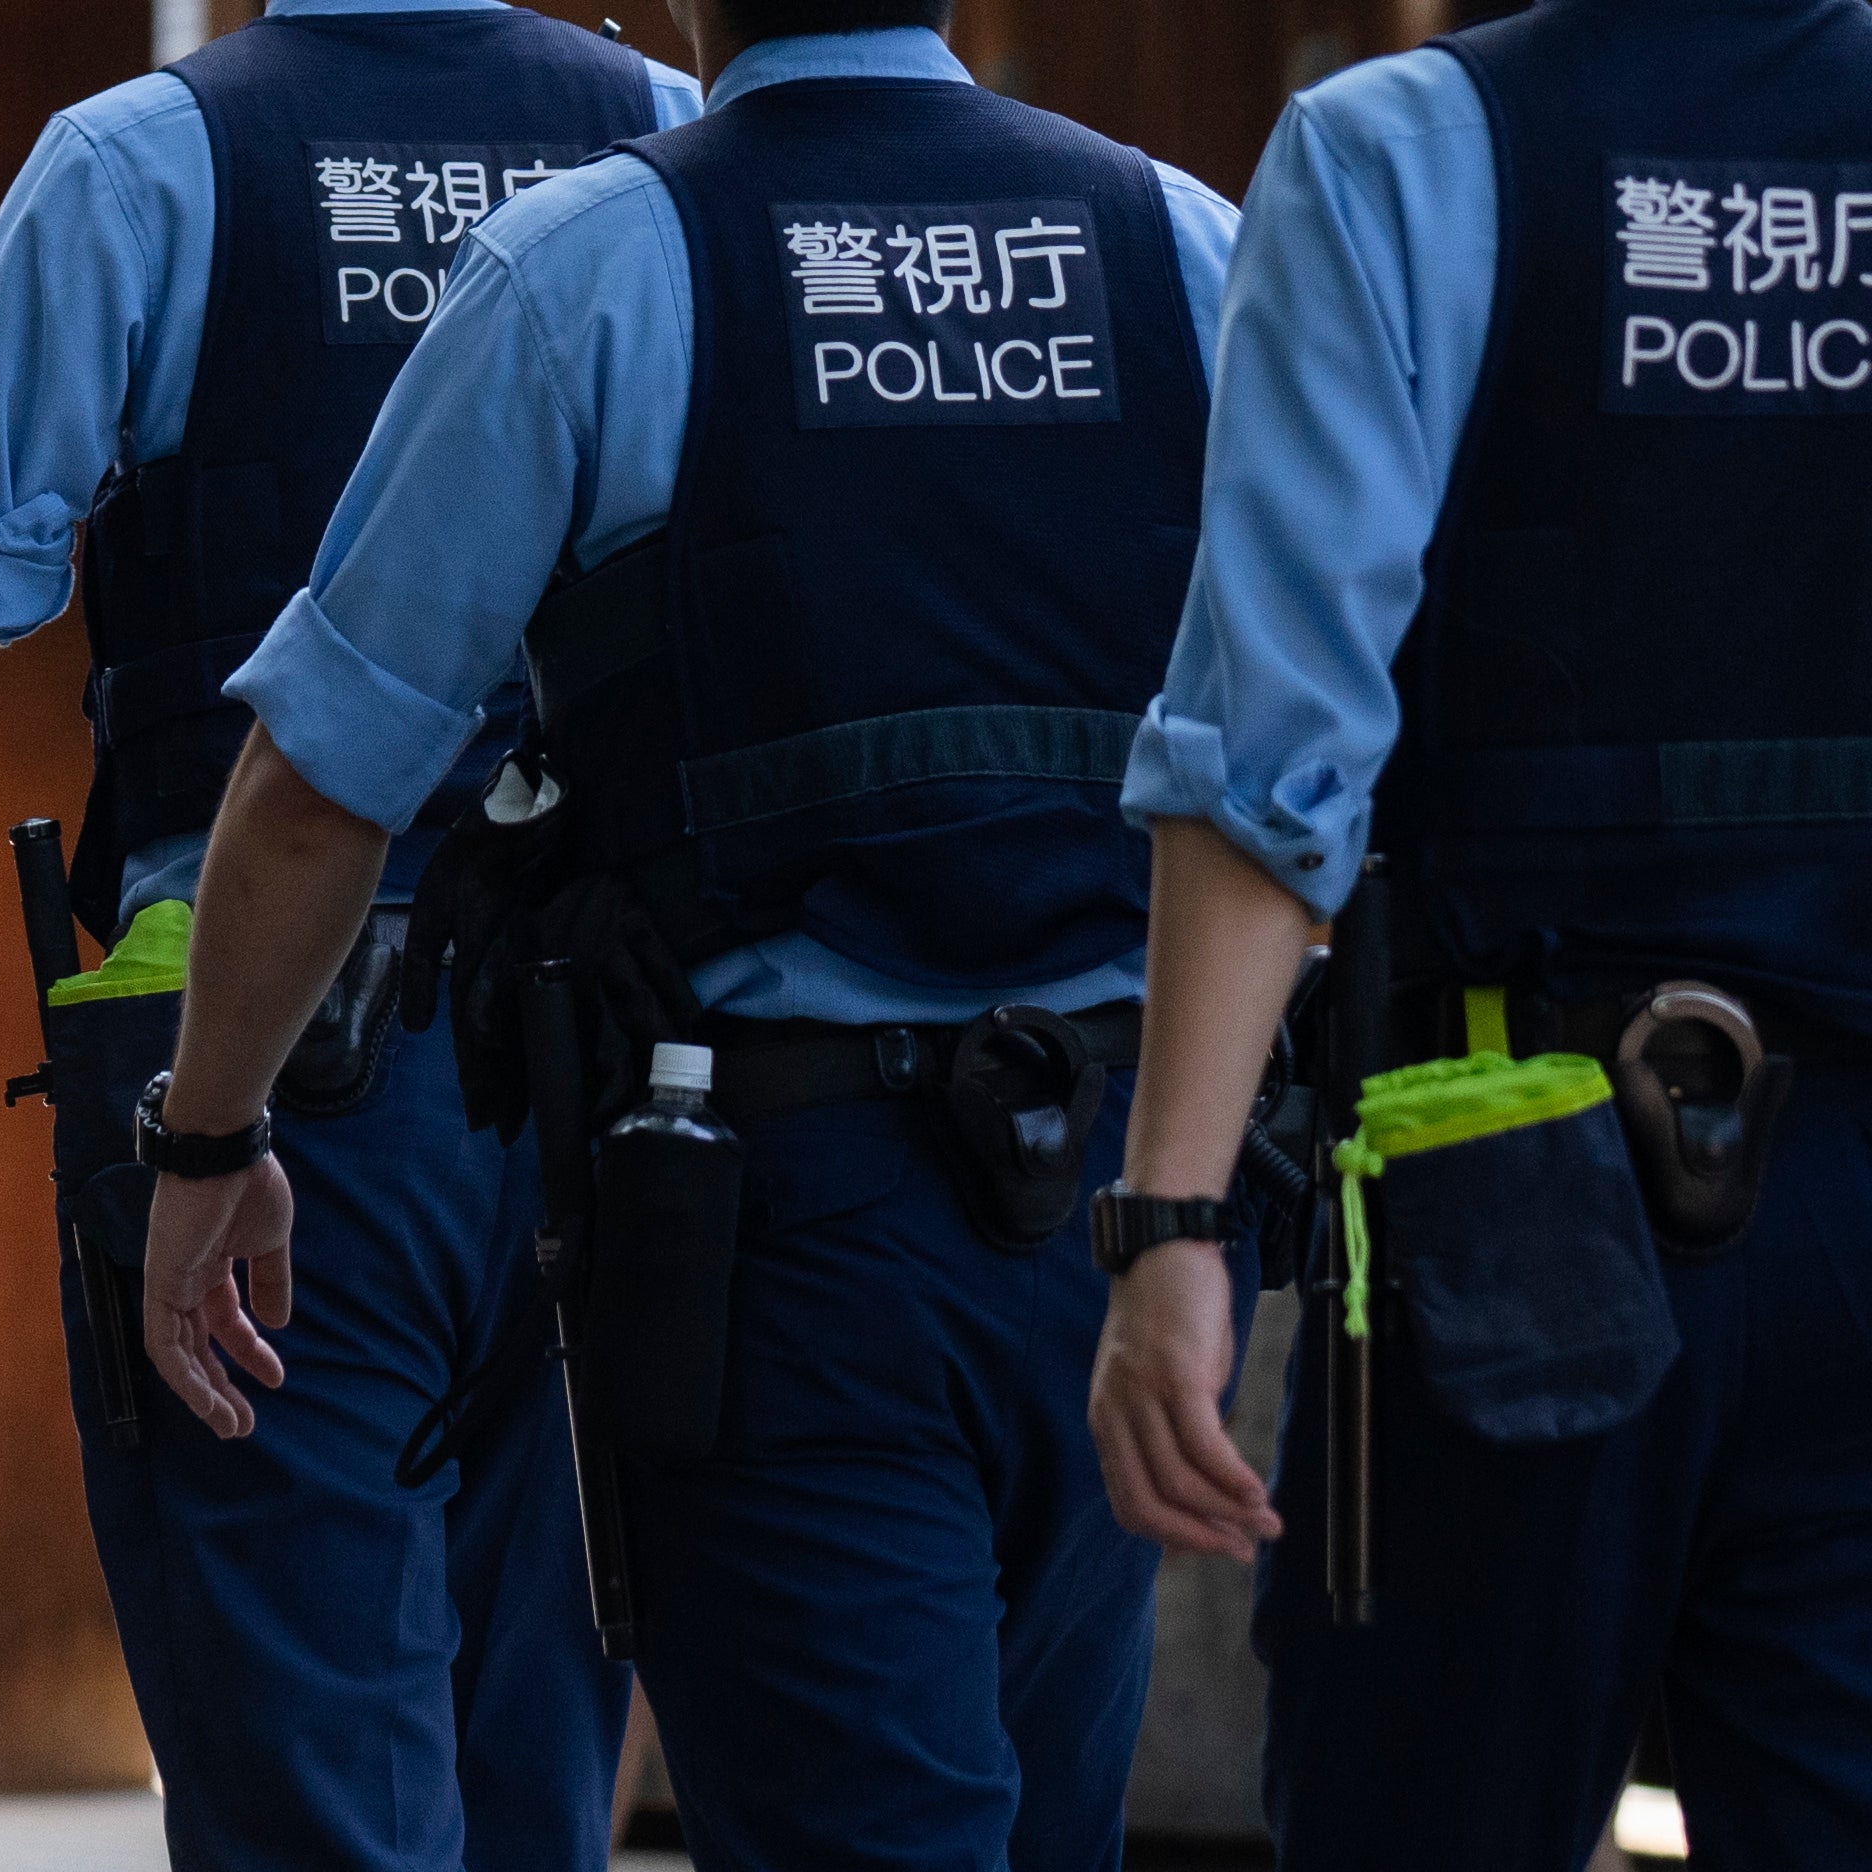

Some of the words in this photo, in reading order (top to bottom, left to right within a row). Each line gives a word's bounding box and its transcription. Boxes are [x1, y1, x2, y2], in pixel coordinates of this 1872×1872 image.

[338, 266, 446, 323] PO
[783, 215, 1087, 315] 警視庁
[814, 334, 1102, 404] POLICE
